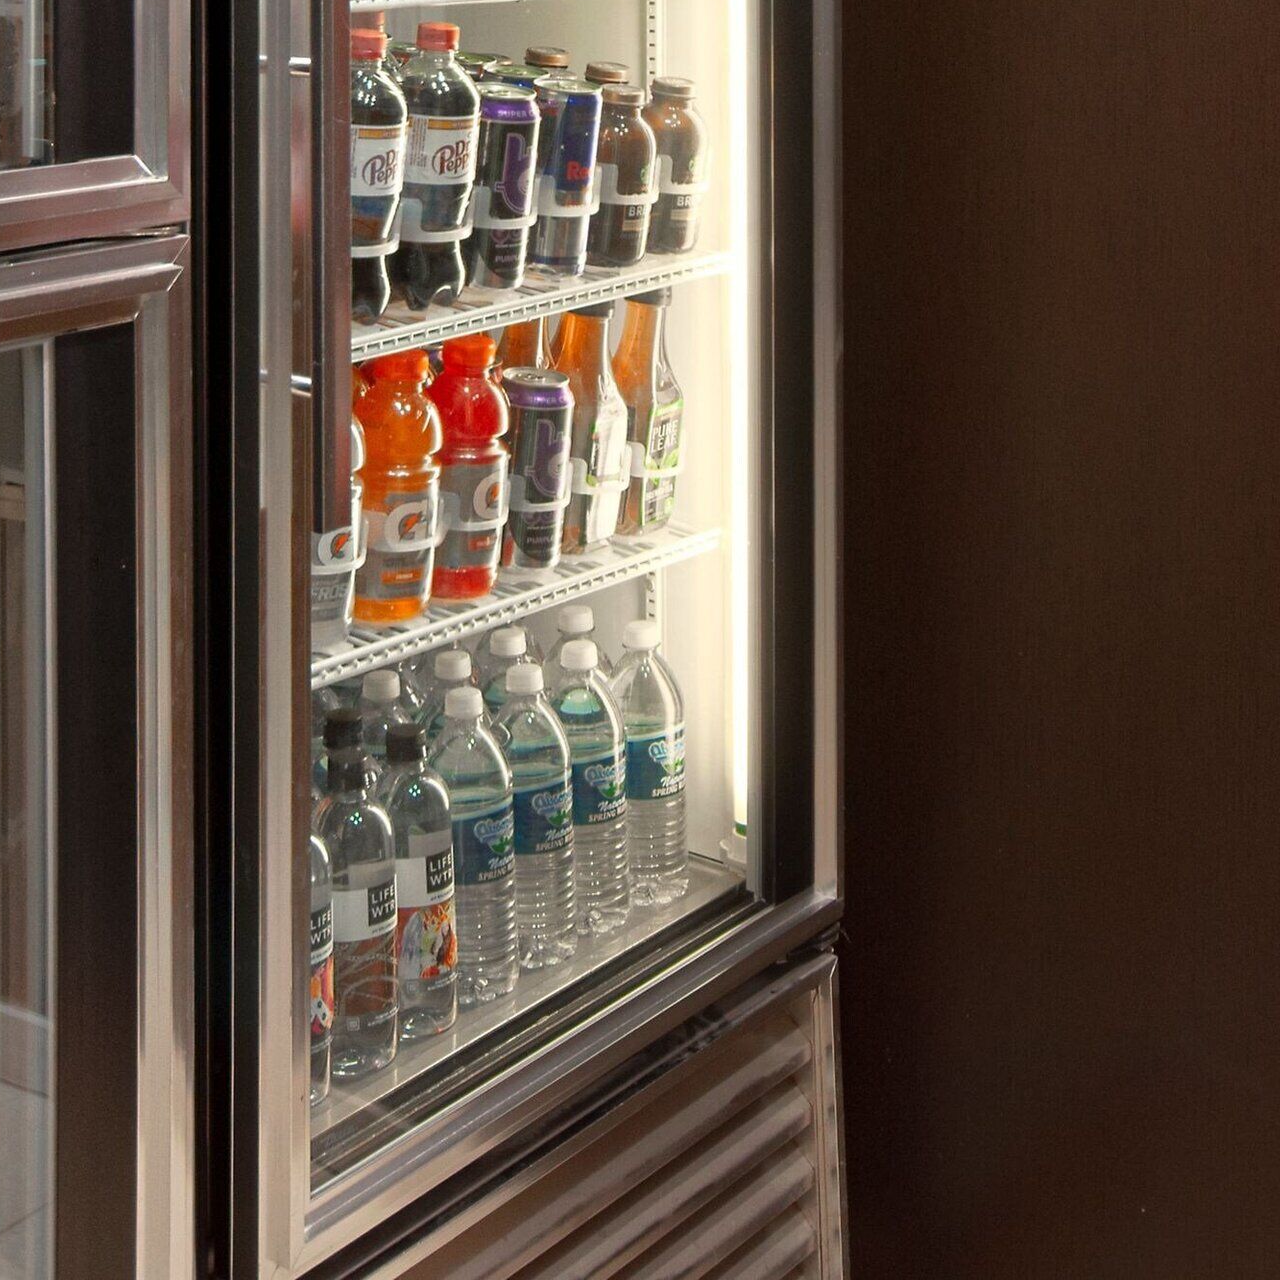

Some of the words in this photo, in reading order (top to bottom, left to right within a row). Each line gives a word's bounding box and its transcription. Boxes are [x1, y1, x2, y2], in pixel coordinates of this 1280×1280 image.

[651, 784, 678, 799] SPRING
[588, 810, 617, 824] SPRING
[429, 854, 452, 873] LIFE
[371, 885, 395, 904] LIFE
[311, 910, 332, 930] LIFE
